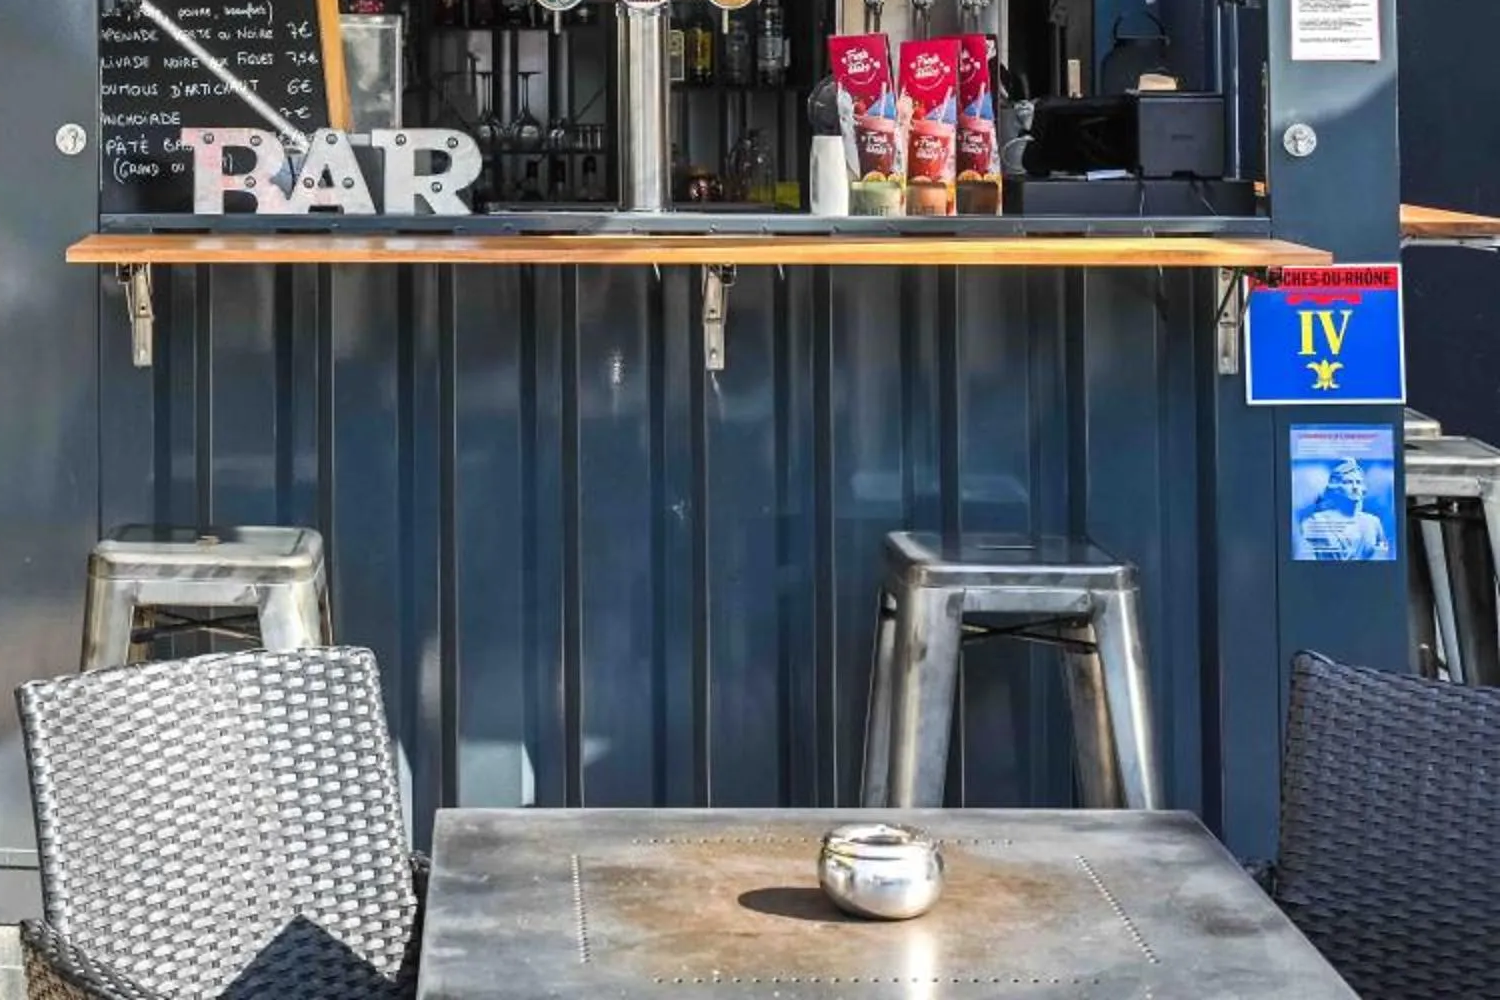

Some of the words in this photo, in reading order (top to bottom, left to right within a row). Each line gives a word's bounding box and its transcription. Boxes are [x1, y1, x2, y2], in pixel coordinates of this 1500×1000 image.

[286, 78, 313, 95] 6€
[180, 127, 484, 216] BAR
[1296, 309, 1354, 355] IV
